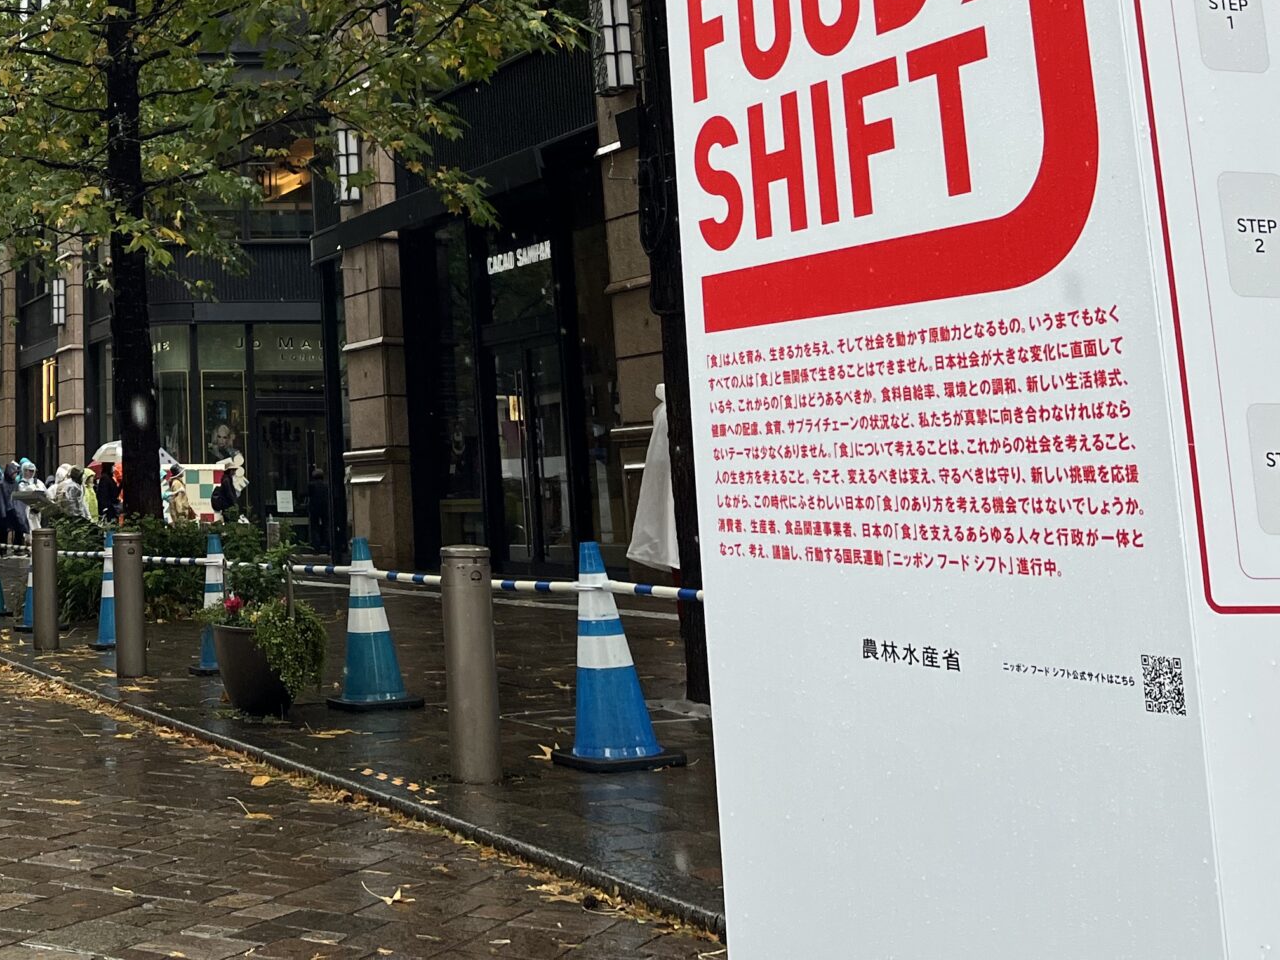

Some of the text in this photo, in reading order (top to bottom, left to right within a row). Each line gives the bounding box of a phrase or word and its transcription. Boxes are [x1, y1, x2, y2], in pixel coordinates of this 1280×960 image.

[1226, 16, 1235, 30] 1
[694, 26, 988, 251] SHIFT
[1237, 218, 1277, 234] STEP
[1255, 238, 1266, 253] 2
[487, 251, 515, 275] CACAO
[862, 638, 961, 672] 農林水産省
